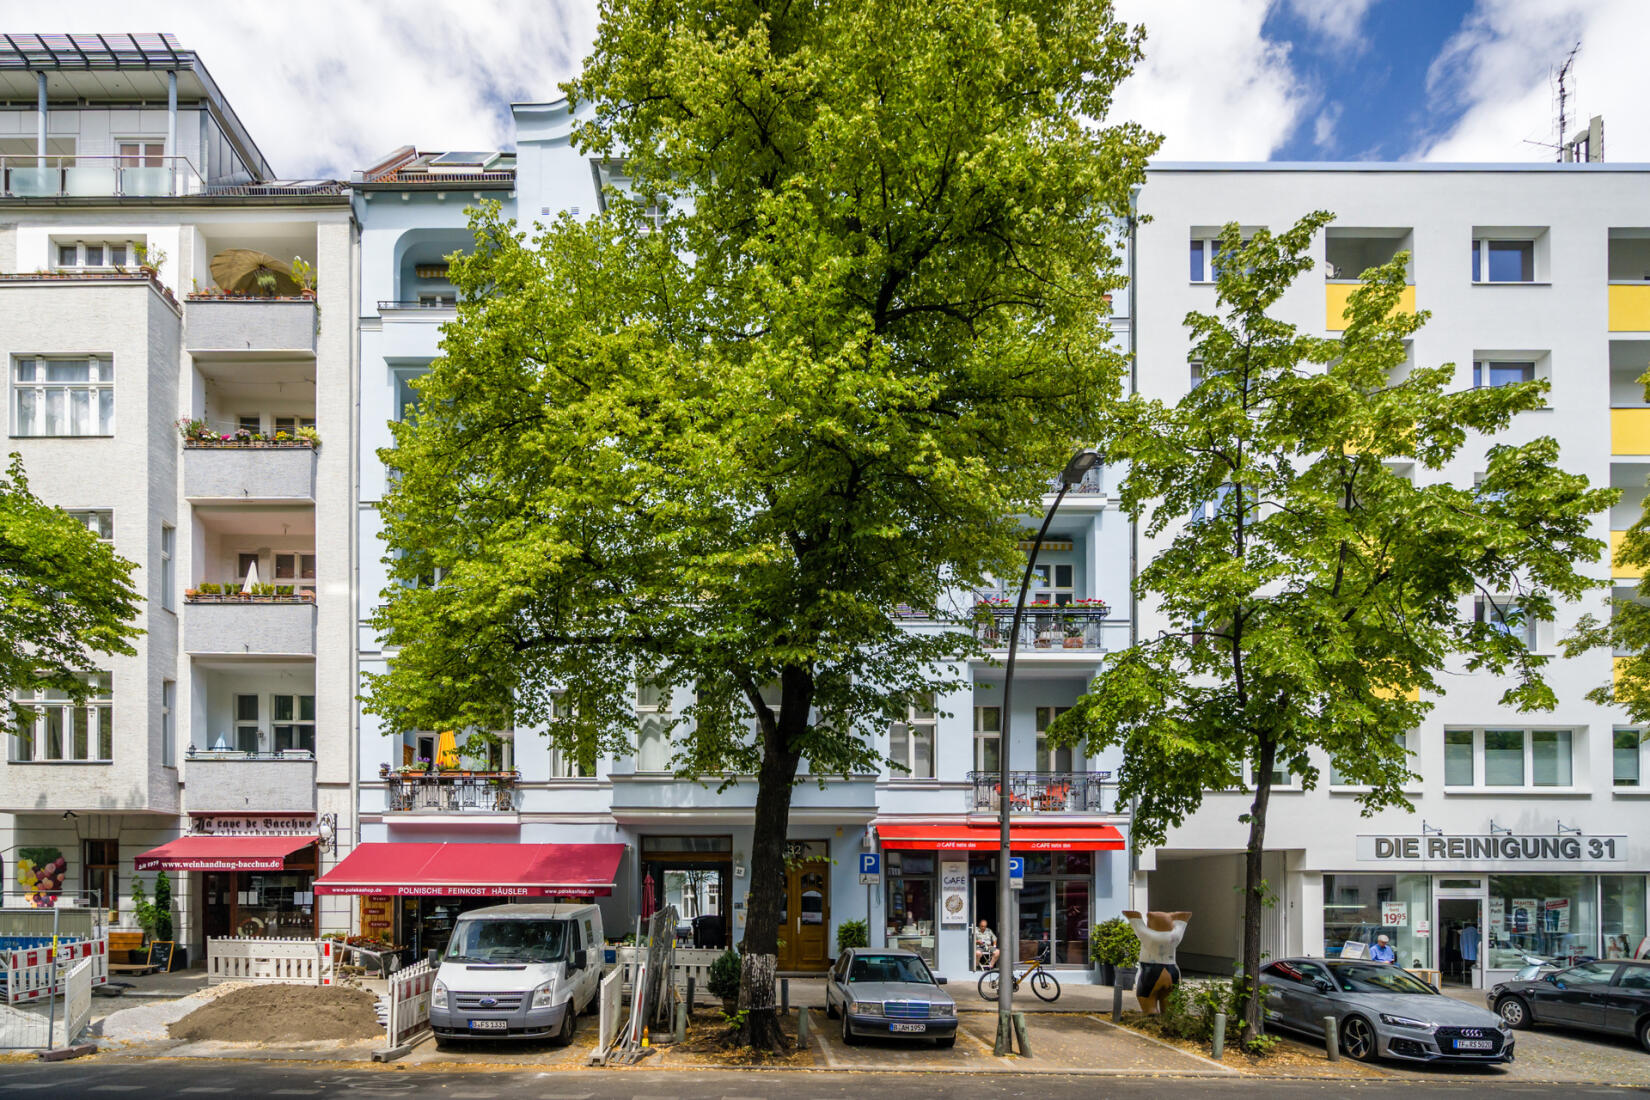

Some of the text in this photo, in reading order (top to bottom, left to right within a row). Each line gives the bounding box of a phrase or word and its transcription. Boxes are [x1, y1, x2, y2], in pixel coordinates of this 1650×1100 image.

[246, 819, 257, 829] de
[263, 818, 313, 829] Bacchus
[1375, 837, 1616, 859] DIE REINIGUNG 31
[161, 860, 280, 869] www.weinhandlung-bacchus.de
[864, 855, 875, 871] P
[398, 887, 443, 895] POLNISCHE
[448, 887, 486, 895] FEINKOST
[492, 887, 528, 895] HÄUSLER
